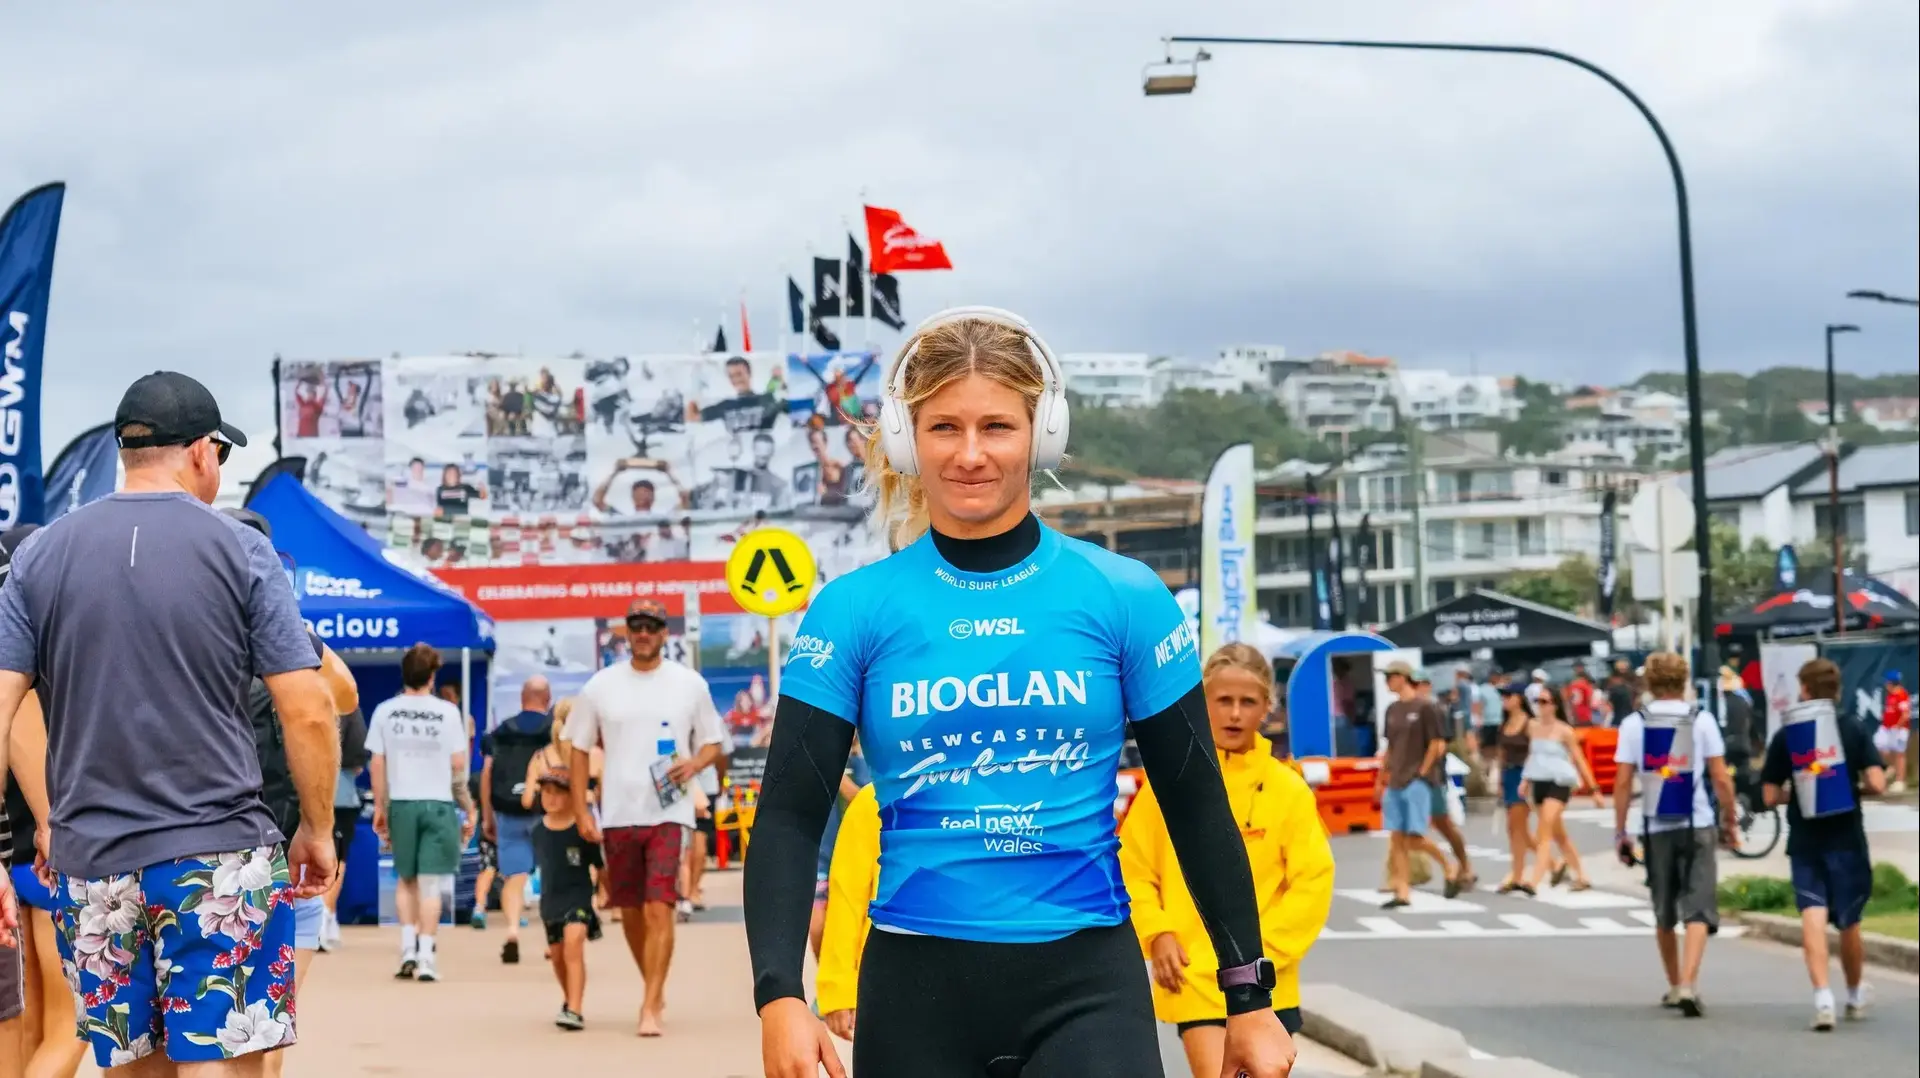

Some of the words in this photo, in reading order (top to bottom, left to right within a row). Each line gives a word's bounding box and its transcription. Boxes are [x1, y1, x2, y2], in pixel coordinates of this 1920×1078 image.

[0, 310, 30, 456] GWM
[934, 566, 966, 589] WORLD
[968, 580, 999, 591] SURF
[1001, 562, 1040, 588] LEAGUE
[974, 617, 1025, 637] WSL
[900, 728, 1085, 753] NEWCASTLE
[940, 814, 981, 830] feel
[985, 814, 1034, 831] new
[984, 837, 1043, 854] wales
